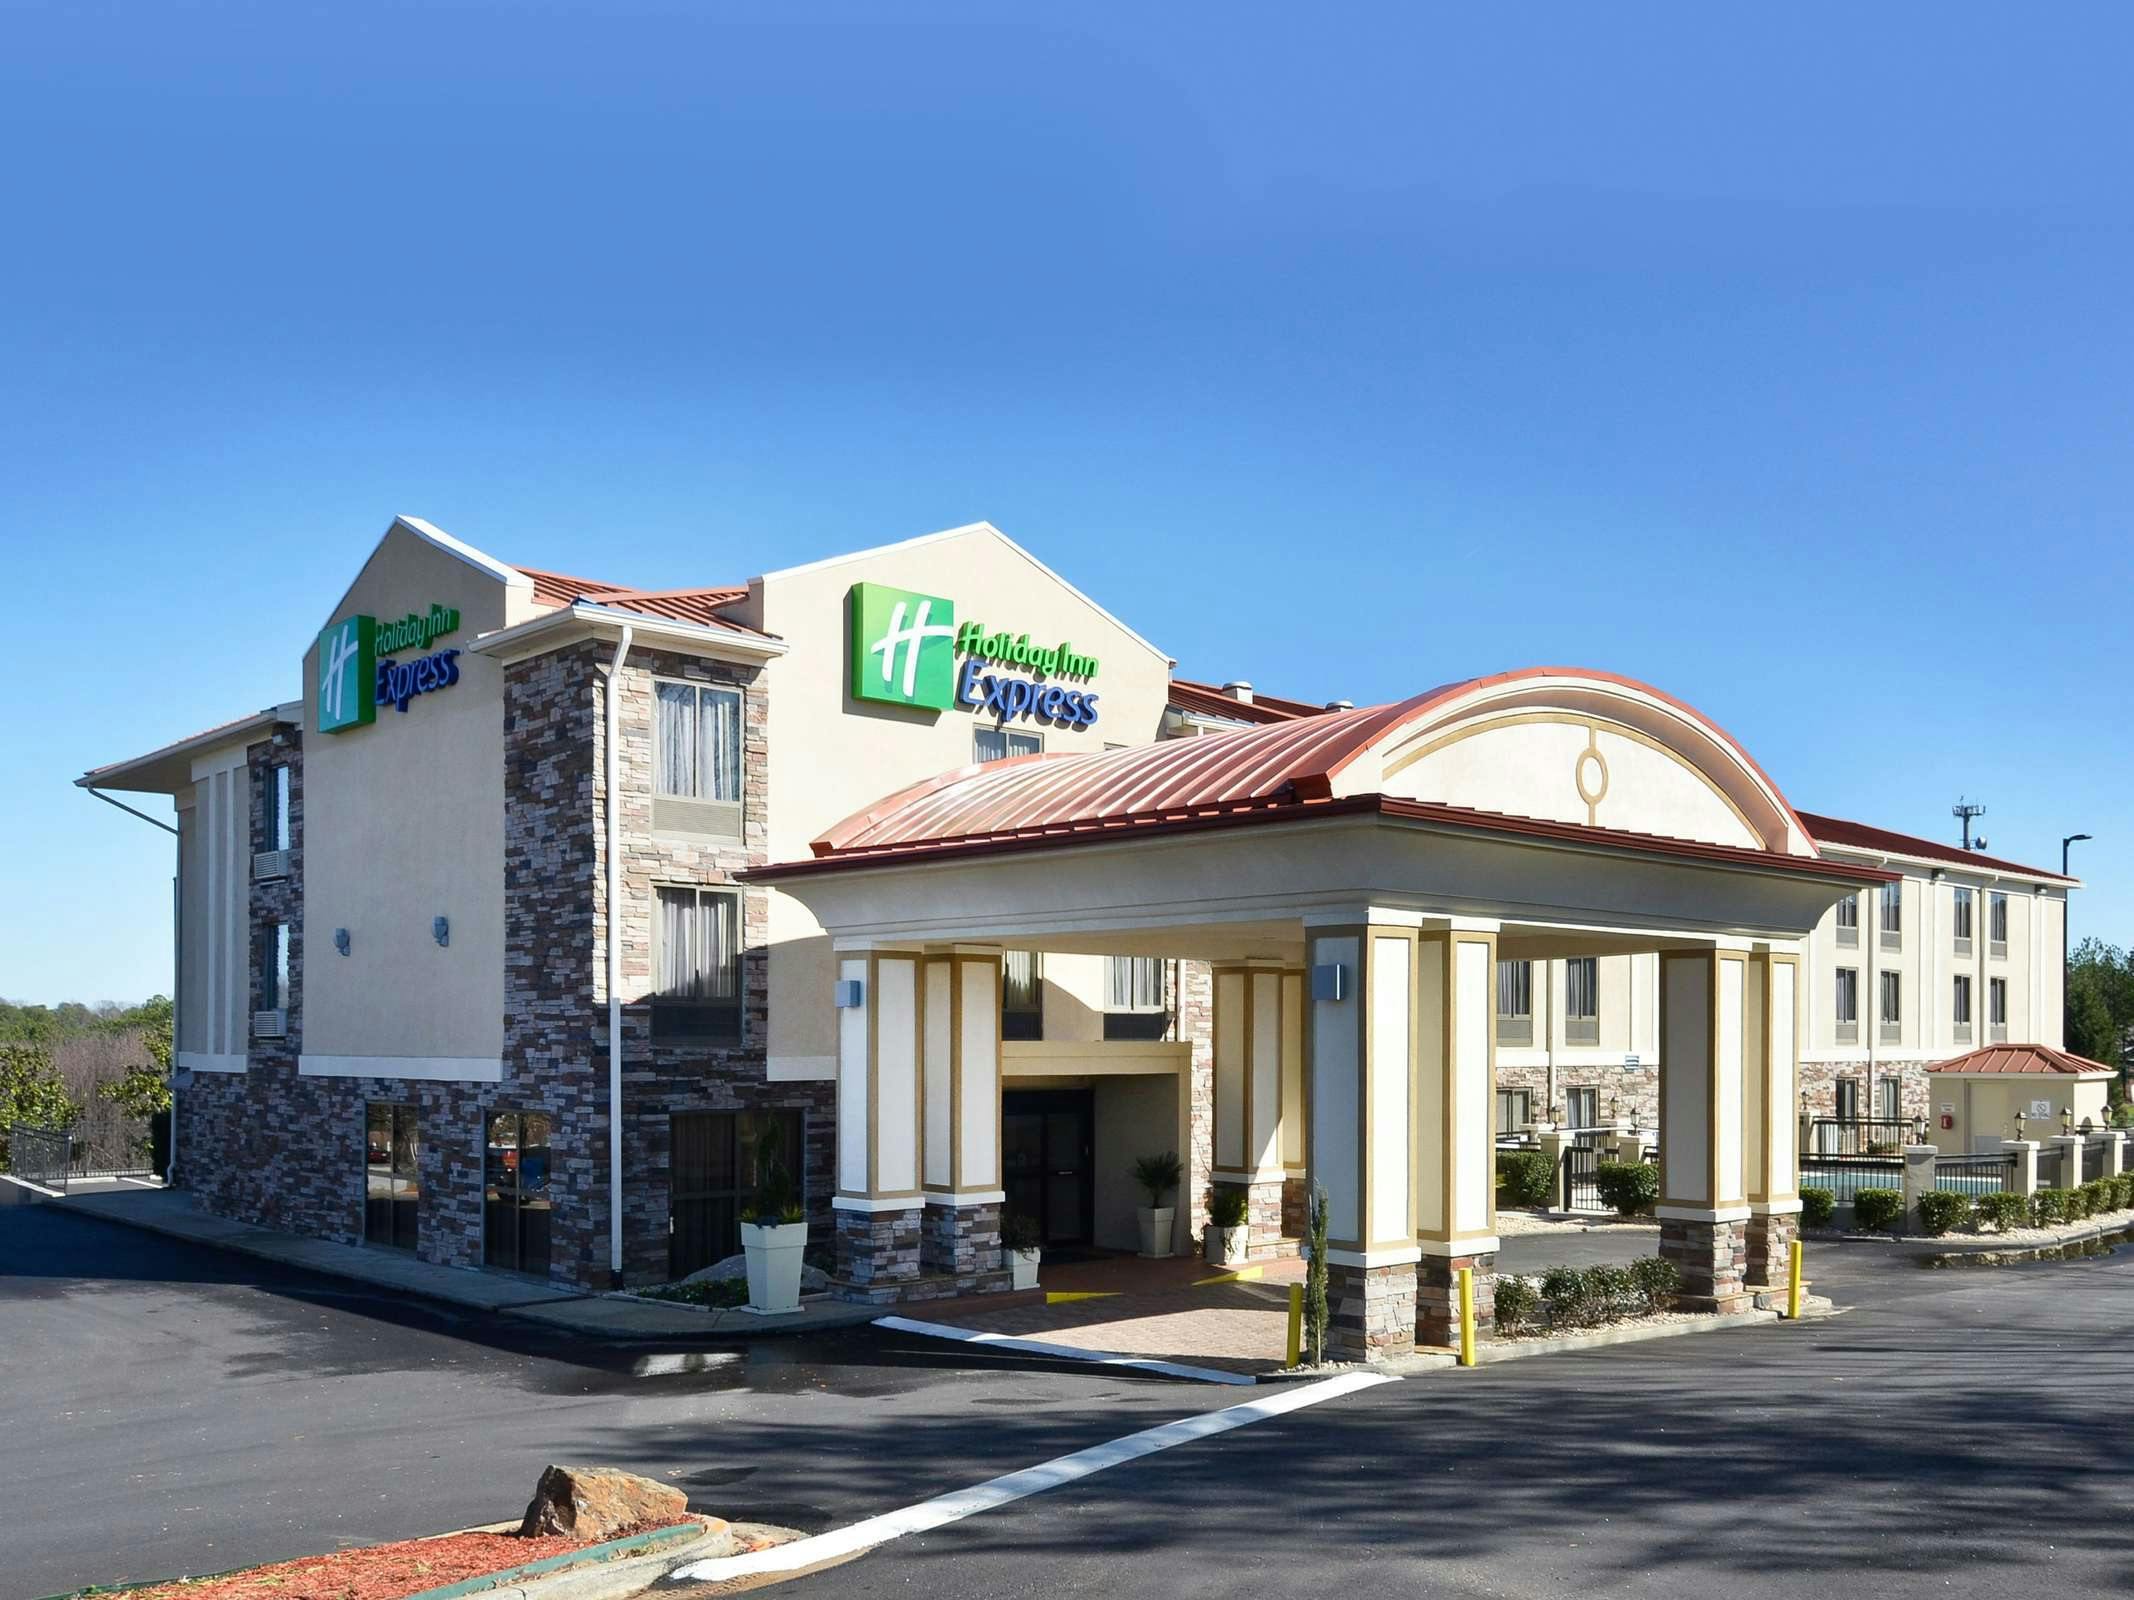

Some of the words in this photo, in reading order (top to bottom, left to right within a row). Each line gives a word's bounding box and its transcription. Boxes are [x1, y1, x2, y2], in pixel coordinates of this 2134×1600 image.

[374, 613, 430, 655] Holiday
[958, 621, 1059, 676] Holiday
[1058, 642, 1099, 678] Inn
[376, 648, 460, 712] Express
[960, 659, 1099, 725] Express
